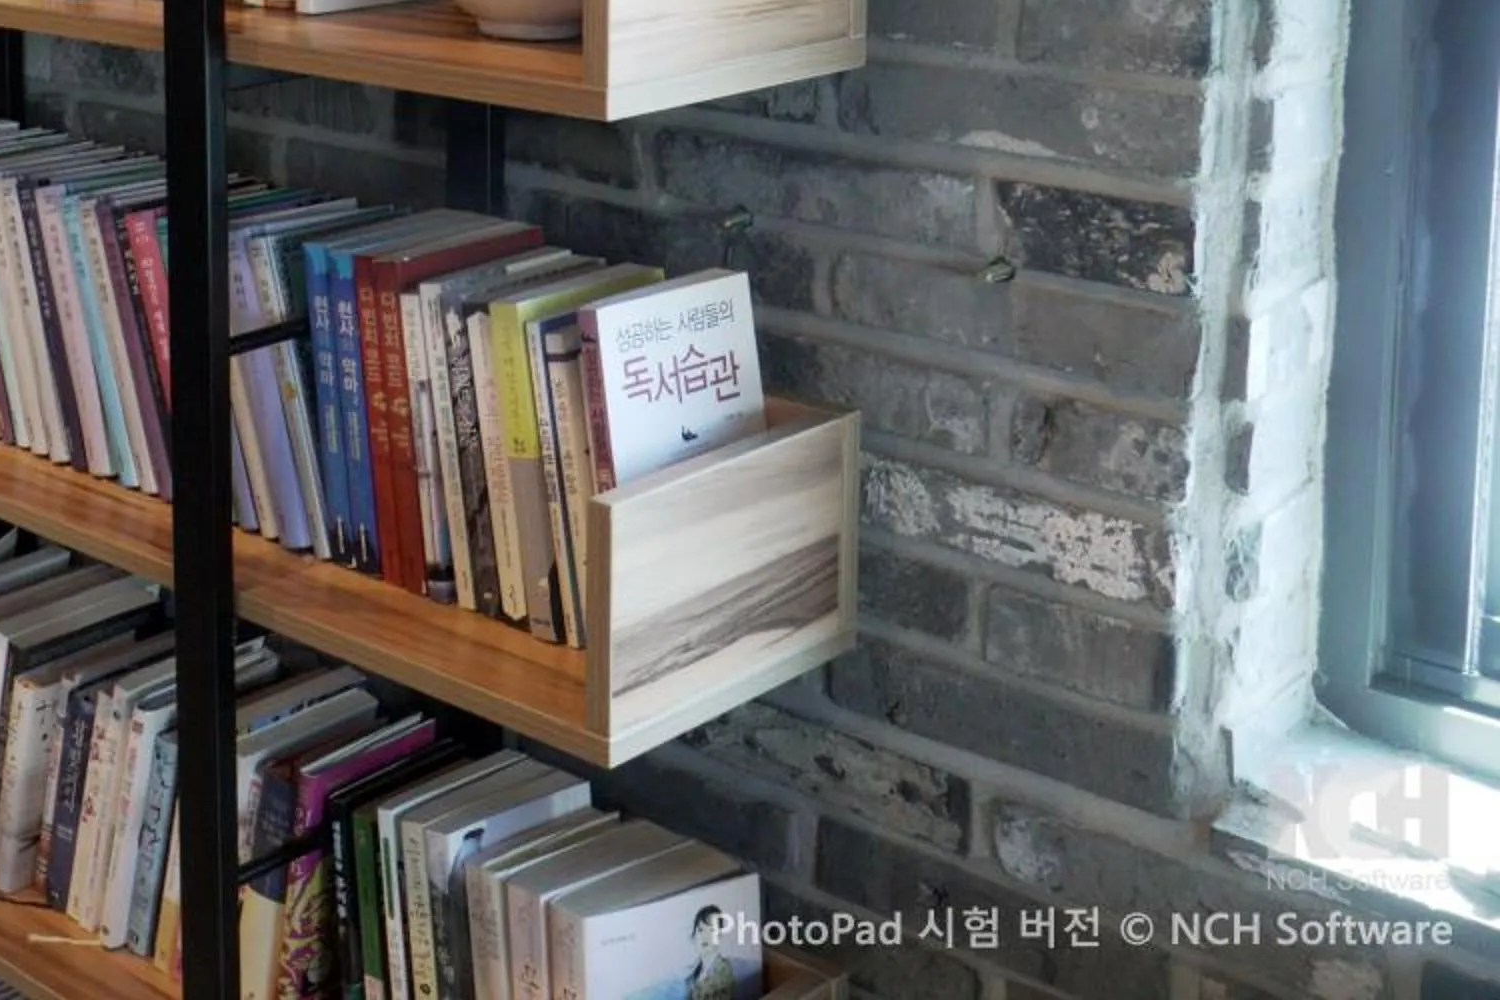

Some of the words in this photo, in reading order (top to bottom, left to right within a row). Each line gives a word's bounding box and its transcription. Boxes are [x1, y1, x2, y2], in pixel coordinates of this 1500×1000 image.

[615, 315, 674, 353] 성공하는
[677, 298, 735, 334] 사람들의
[318, 350, 335, 388] 악마
[340, 357, 359, 394] 악마
[622, 343, 742, 404] 독서습관
